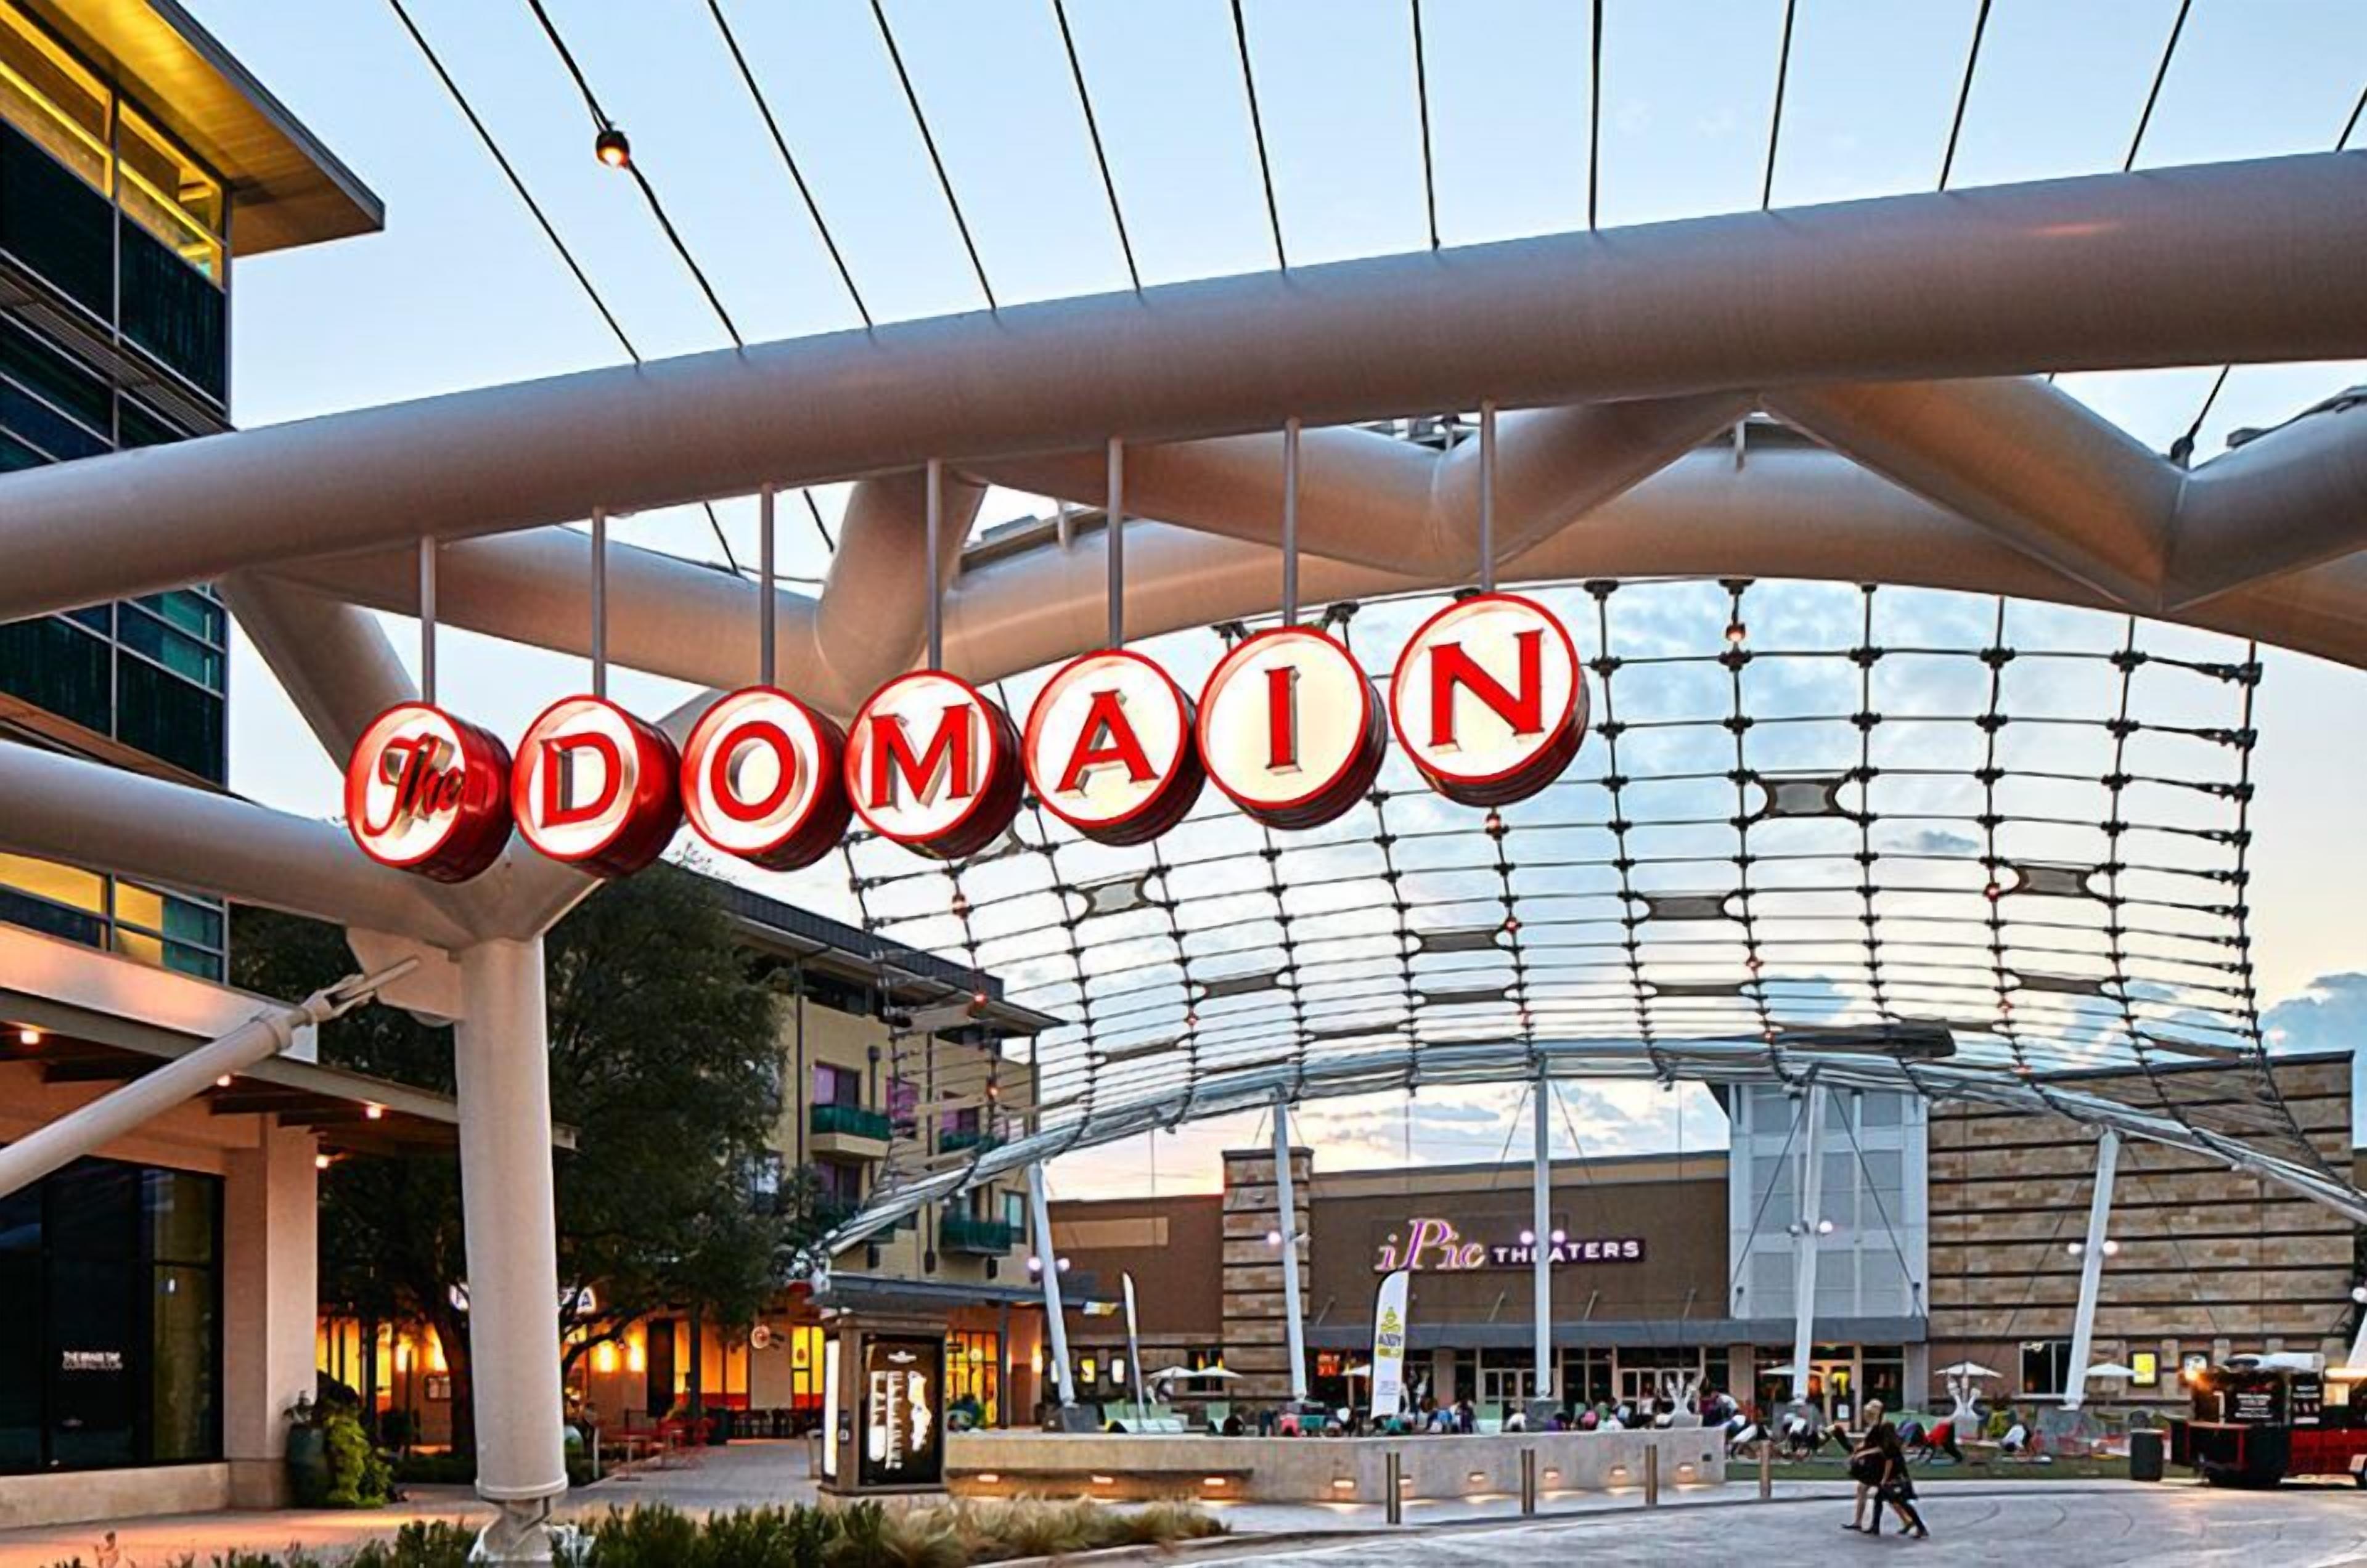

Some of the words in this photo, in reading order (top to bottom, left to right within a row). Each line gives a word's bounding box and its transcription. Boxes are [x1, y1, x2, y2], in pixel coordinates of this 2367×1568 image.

[362, 732, 464, 836] The
[538, 629, 1545, 828] DOMAIN
[1374, 1218, 1486, 1271] iPic
